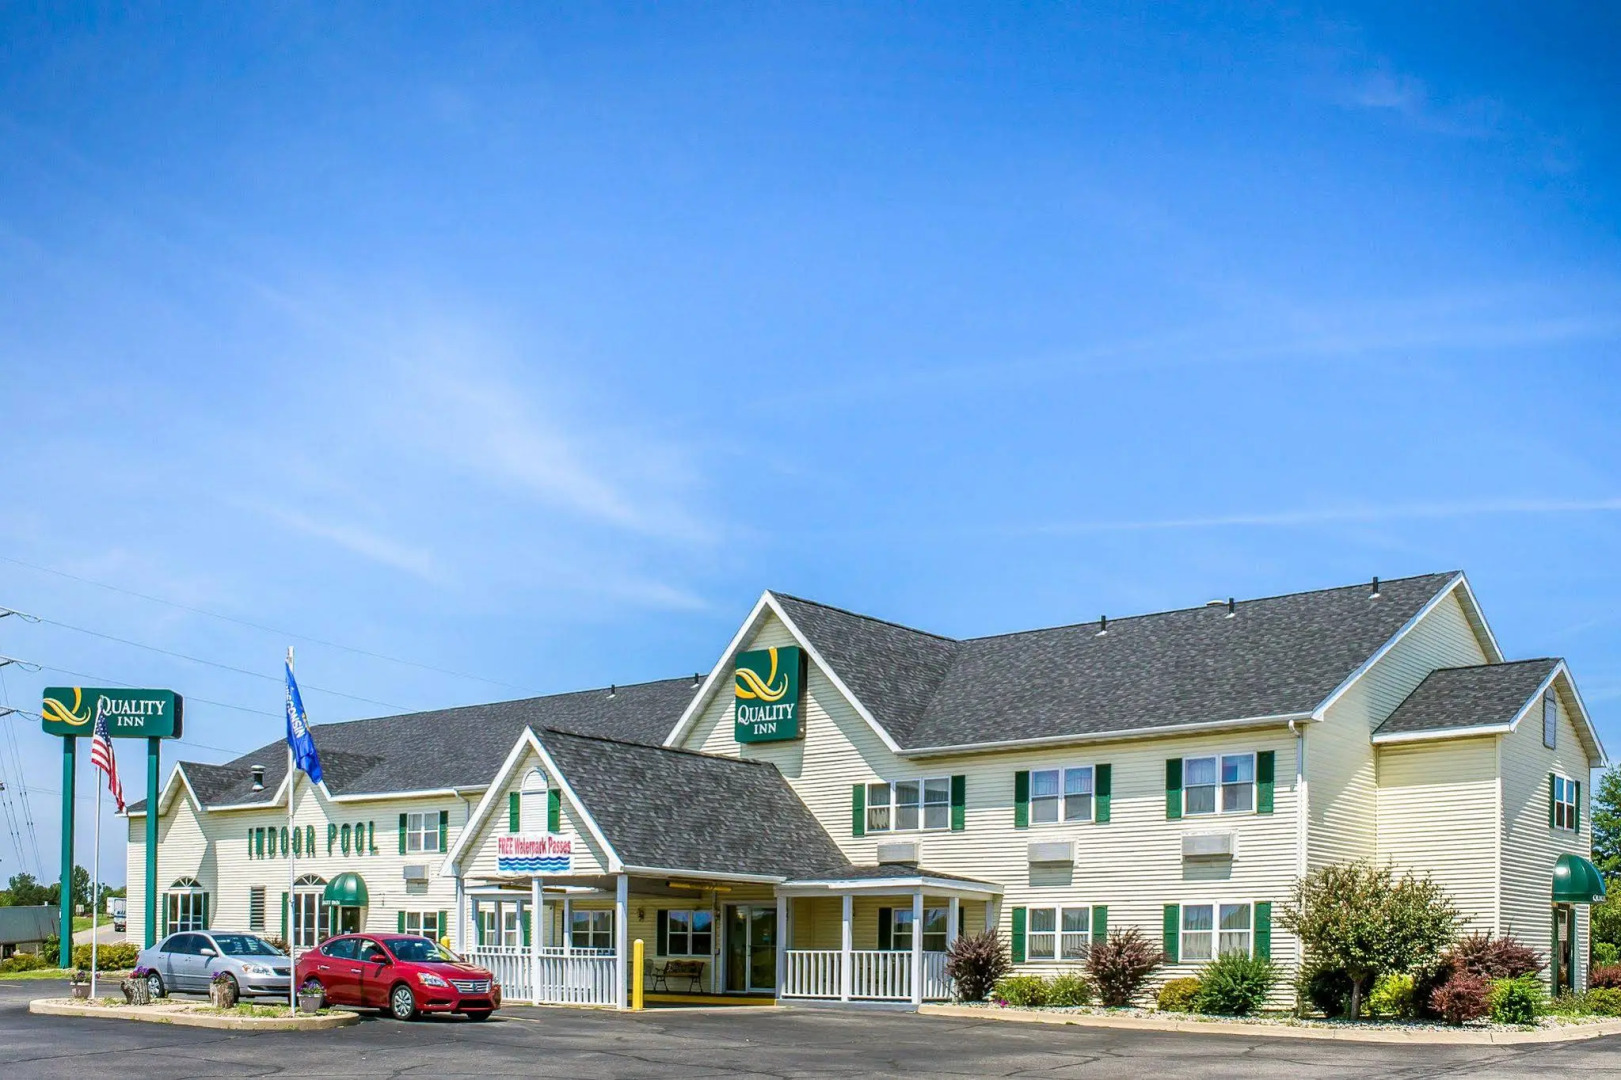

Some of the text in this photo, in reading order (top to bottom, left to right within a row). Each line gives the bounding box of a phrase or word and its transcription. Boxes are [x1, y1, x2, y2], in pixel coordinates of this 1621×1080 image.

[97, 695, 166, 716] QUALITY
[737, 703, 795, 725] QUALITY
[117, 716, 144, 726] INN
[753, 722, 777, 735] INN
[248, 820, 379, 860] INDOOR POOL
[498, 836, 571, 857] FREE Waterpark Passes
